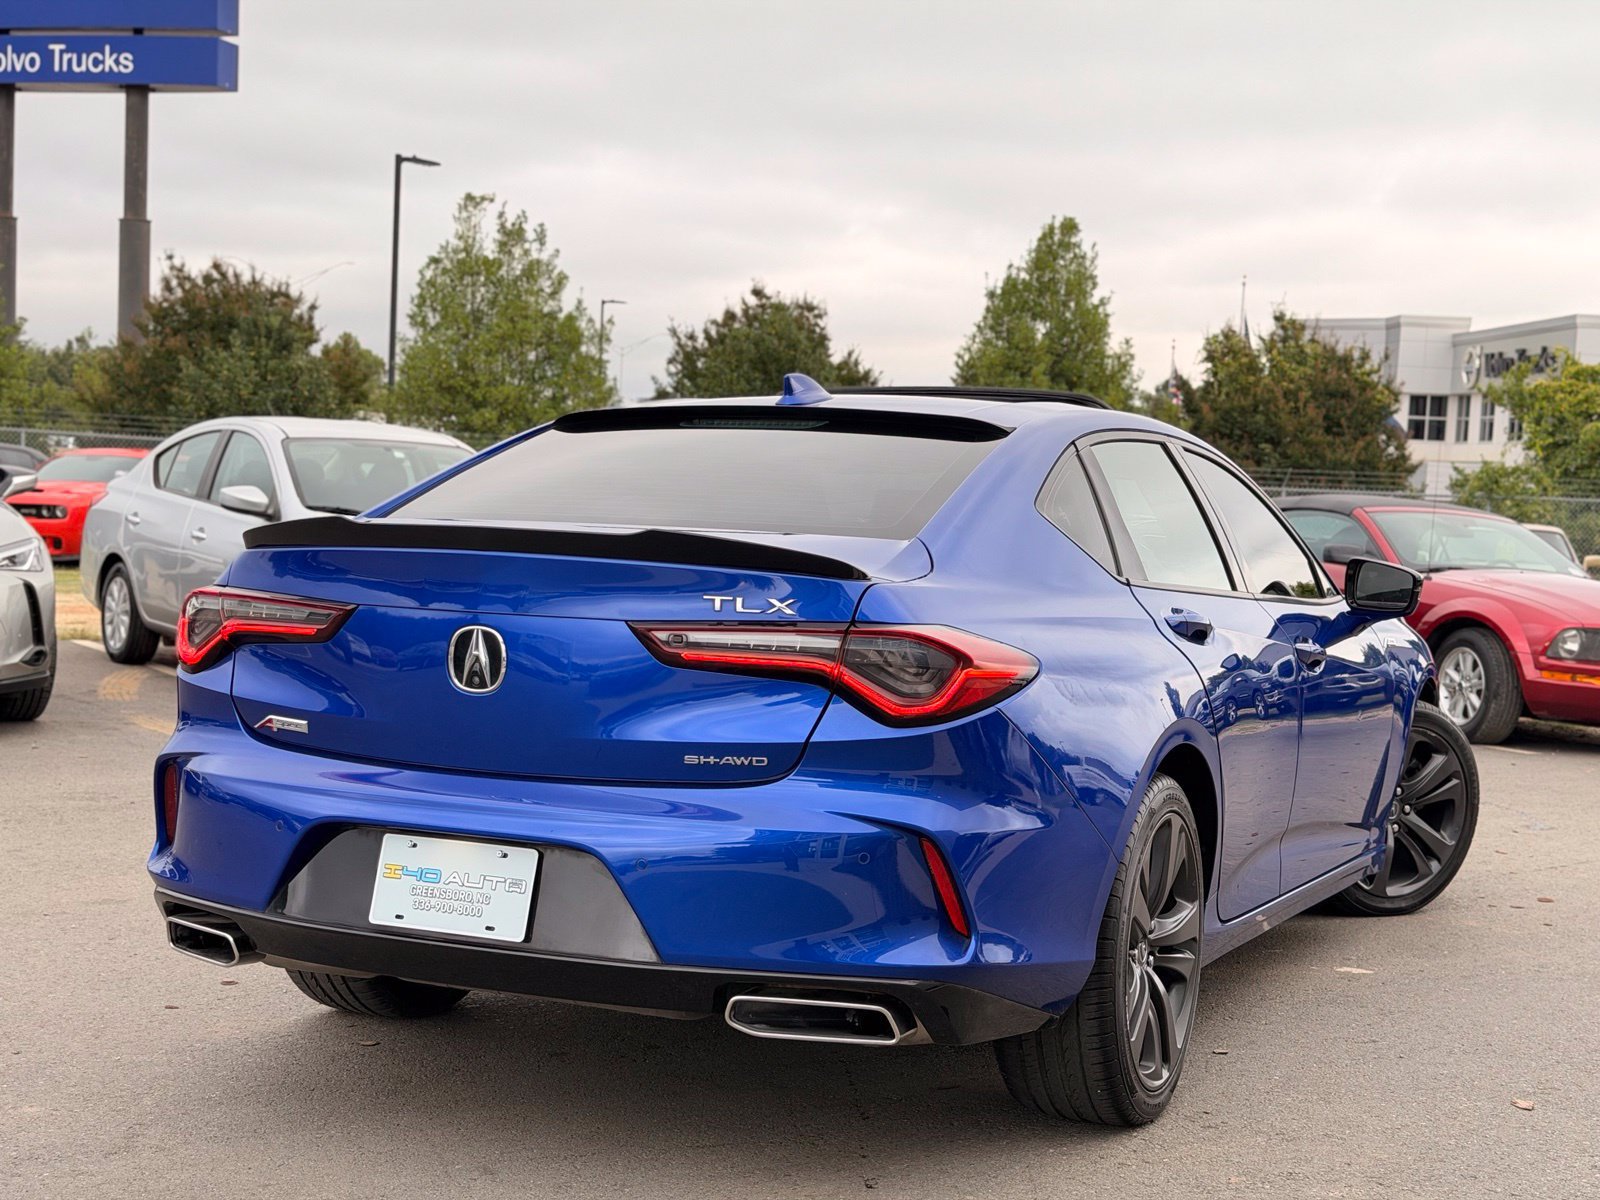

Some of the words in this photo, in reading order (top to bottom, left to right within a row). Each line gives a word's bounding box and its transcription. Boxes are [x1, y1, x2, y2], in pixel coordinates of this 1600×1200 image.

[48, 43, 134, 74] Trucks
[702, 594, 798, 615] TLX
[683, 755, 768, 766] SH-AWD
[443, 871, 527, 894] AUTO
[409, 884, 475, 904] GREENSBORO,
[475, 892, 492, 905] NC
[412, 898, 484, 917] 336-900-8000
